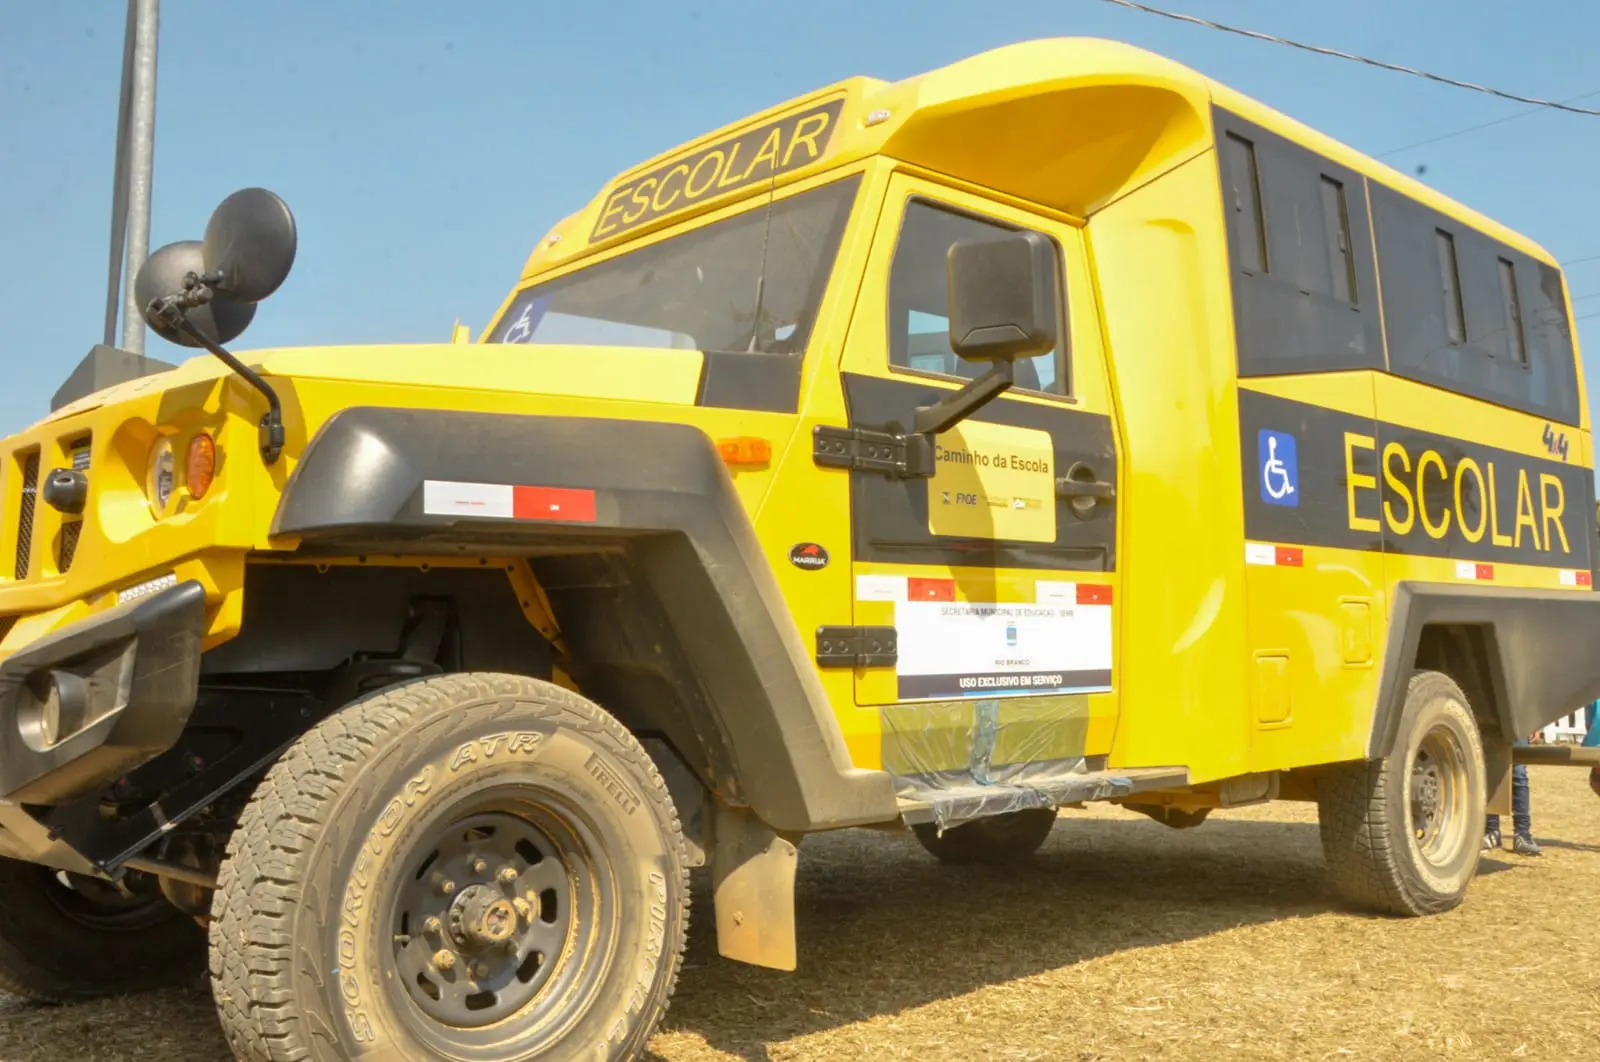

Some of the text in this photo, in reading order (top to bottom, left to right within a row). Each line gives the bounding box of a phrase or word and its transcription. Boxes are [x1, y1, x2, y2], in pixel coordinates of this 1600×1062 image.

[594, 111, 830, 237] ESCOLAR
[935, 444, 1049, 474] Caminho da Escola
[1343, 431, 1571, 554] ESCOLAR
[942, 607, 979, 617] SECRETARIA
[980, 607, 1013, 617] MUNICIPAL
[959, 674, 1062, 689] USO EXCLUSIVO EM SERVIÇO
[1007, 658, 1030, 666] BRANCO
[583, 751, 642, 816] PIRELLI
[338, 731, 543, 1043] SCORPION ATR
